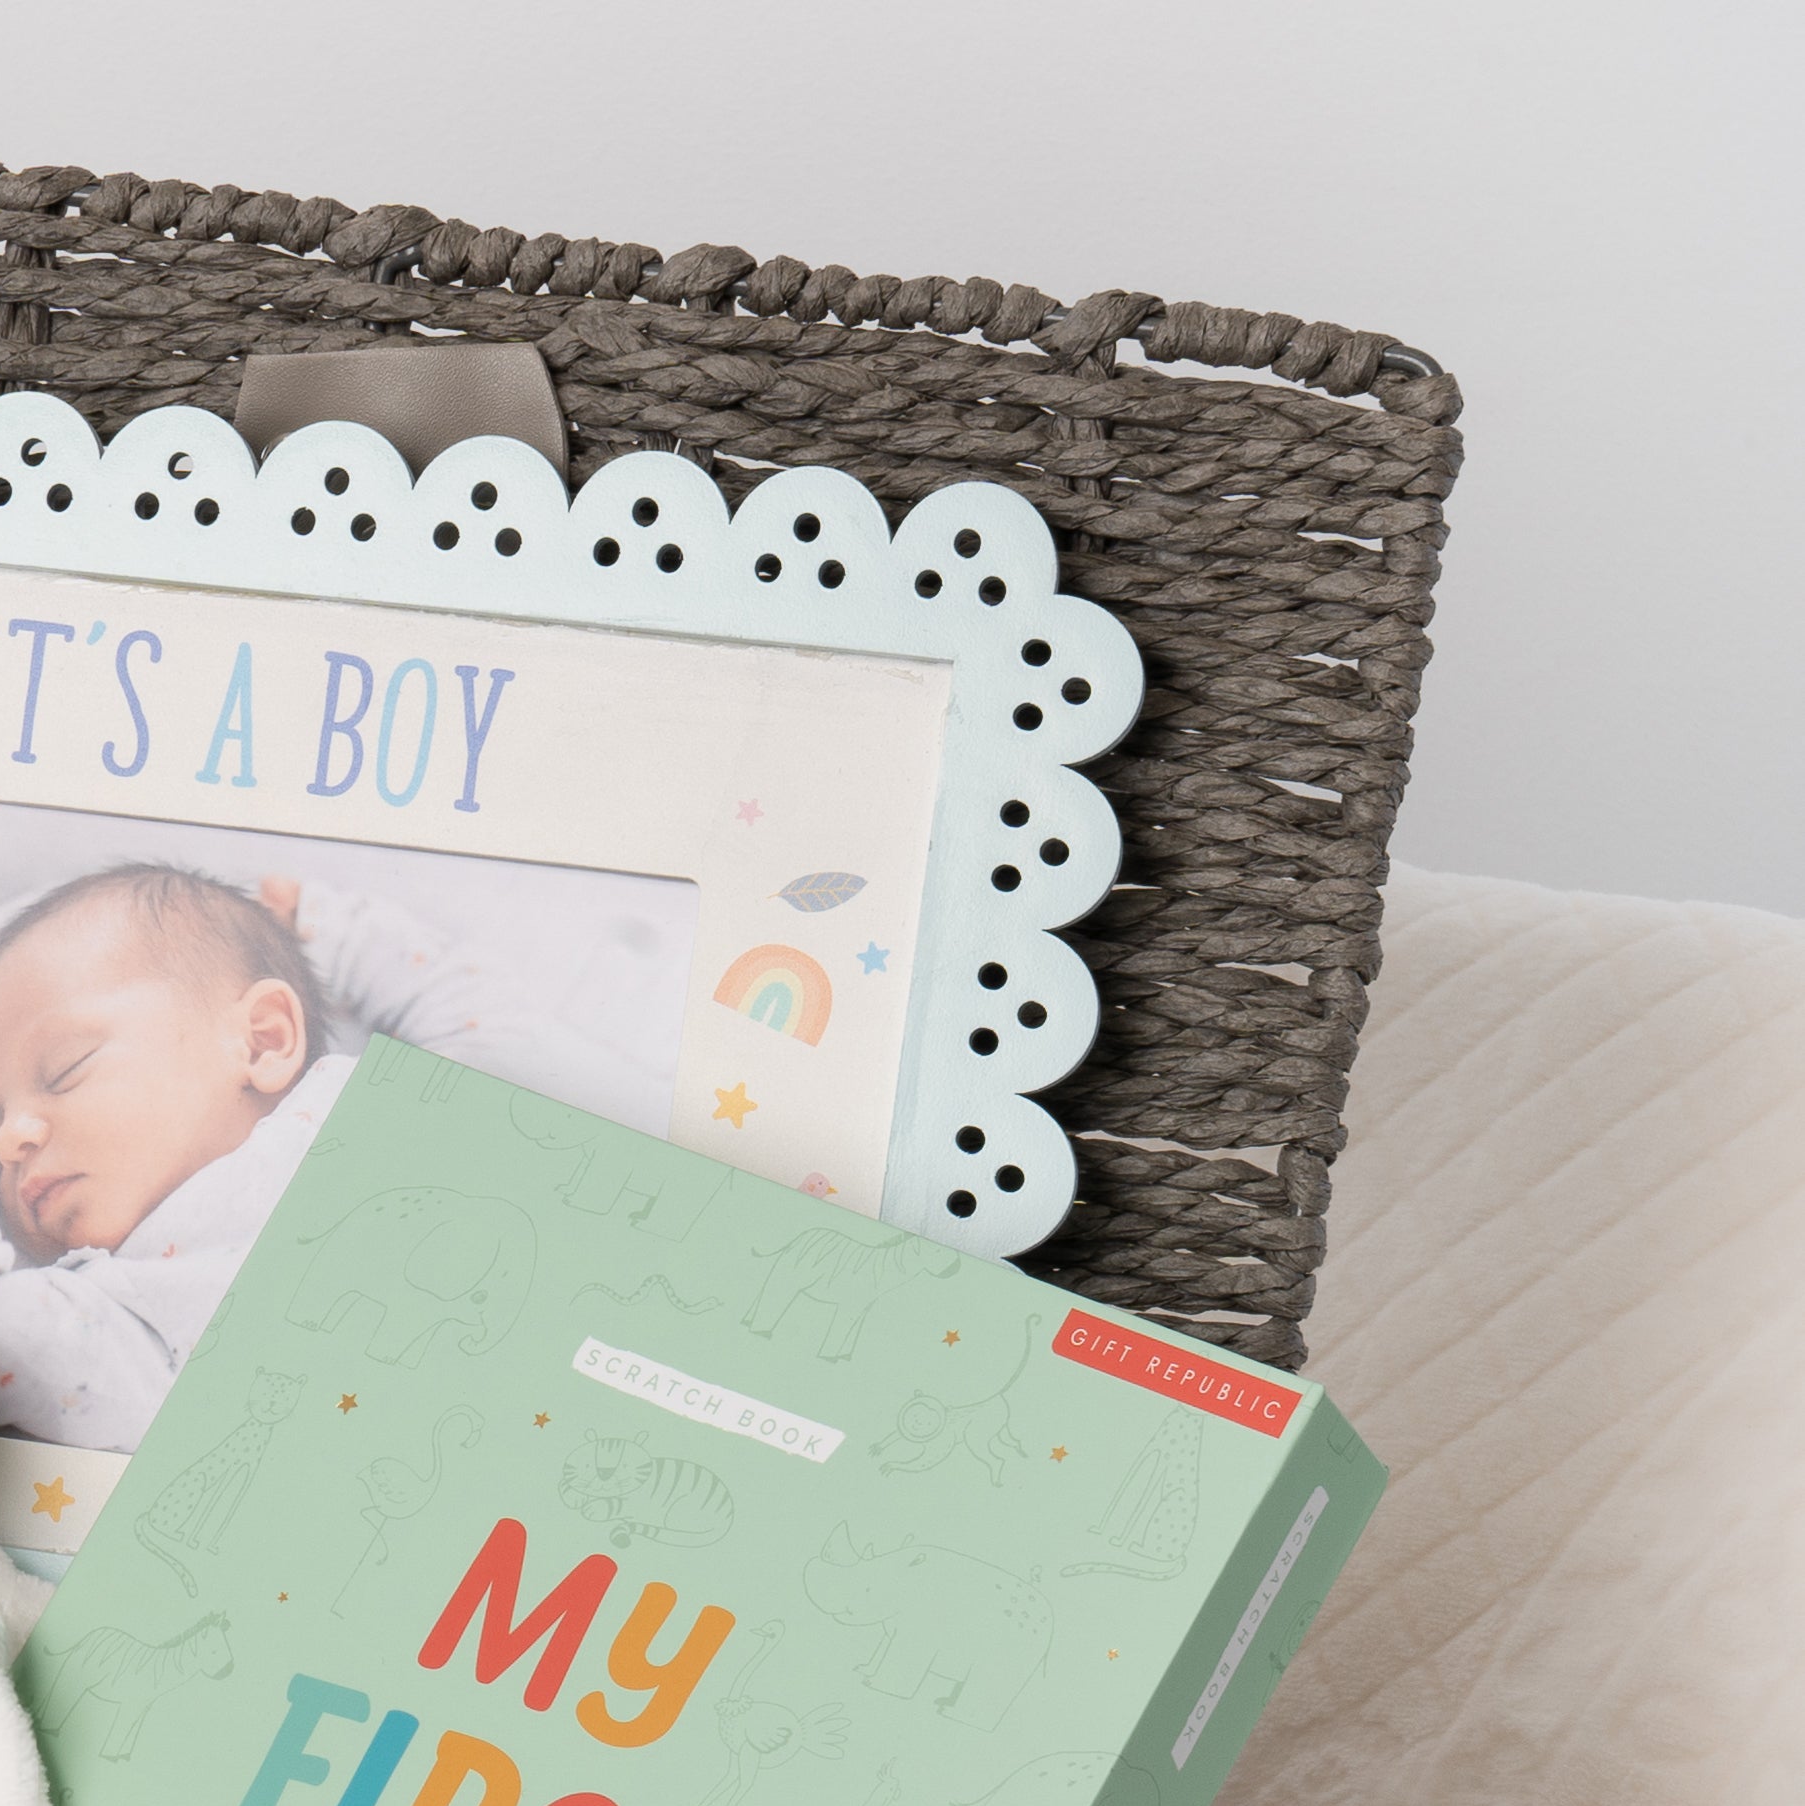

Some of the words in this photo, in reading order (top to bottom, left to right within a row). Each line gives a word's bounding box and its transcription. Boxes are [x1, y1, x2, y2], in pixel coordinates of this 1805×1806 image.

[195, 641, 257, 788] A
[306, 650, 515, 813] BOY
[584, 1348, 723, 1415] SCRATCH
[737, 1409, 824, 1456] BOOK
[1069, 1328, 1132, 1363] GIFT
[1145, 1356, 1282, 1420] REPUBLIC
[1237, 1512, 1313, 1646] SCRATCH
[1183, 1662, 1231, 1742] BOOK
